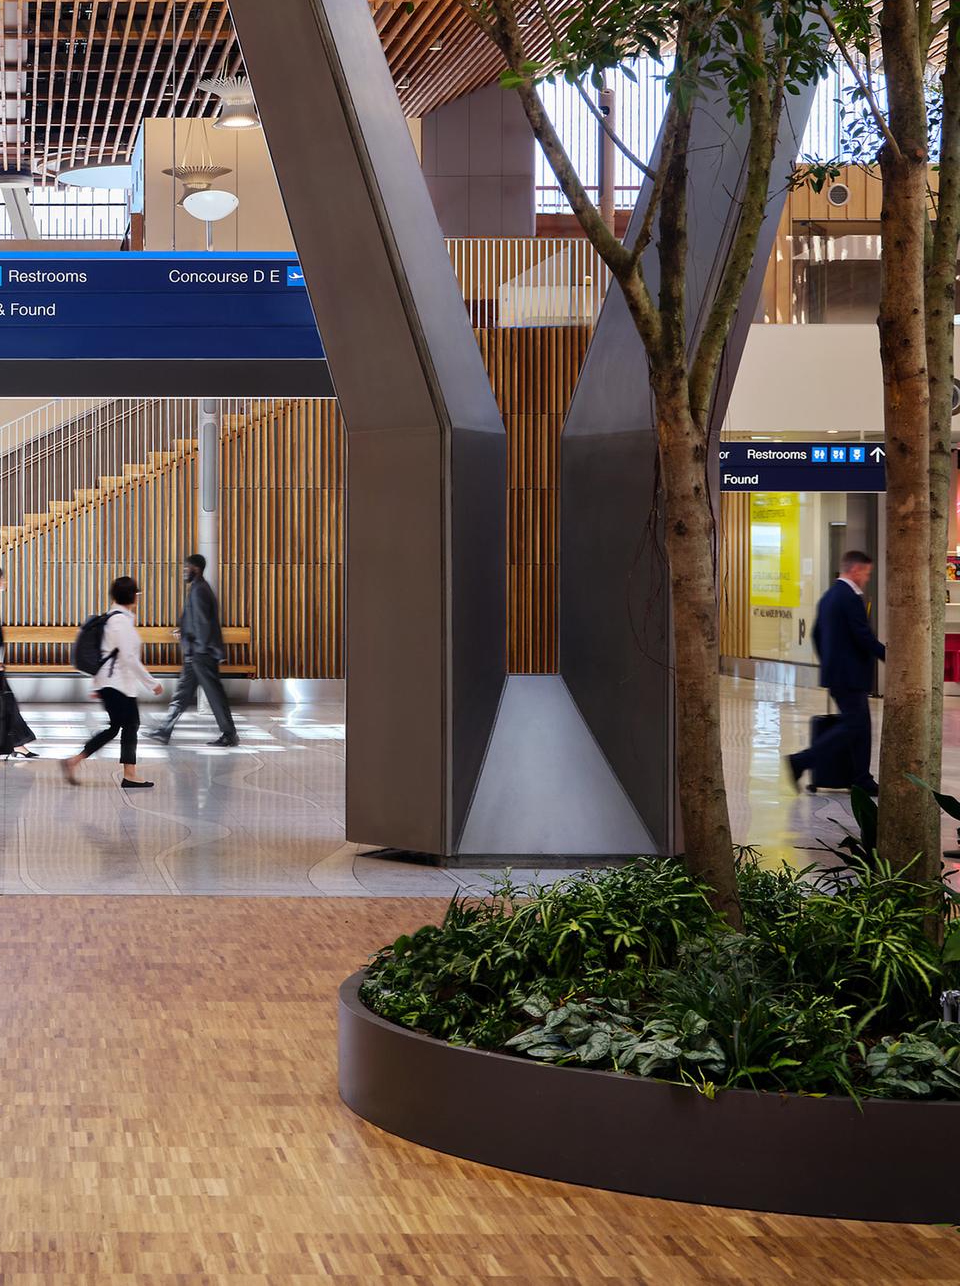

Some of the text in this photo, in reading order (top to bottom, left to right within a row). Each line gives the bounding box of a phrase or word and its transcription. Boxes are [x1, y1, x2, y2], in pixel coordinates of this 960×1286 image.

[8, 269, 88, 283] Restrooms
[168, 269, 280, 283] Concourse D E
[10, 302, 56, 316] Found
[719, 451, 731, 460] or
[747, 448, 808, 460] Restrooms
[723, 473, 759, 485] Found
